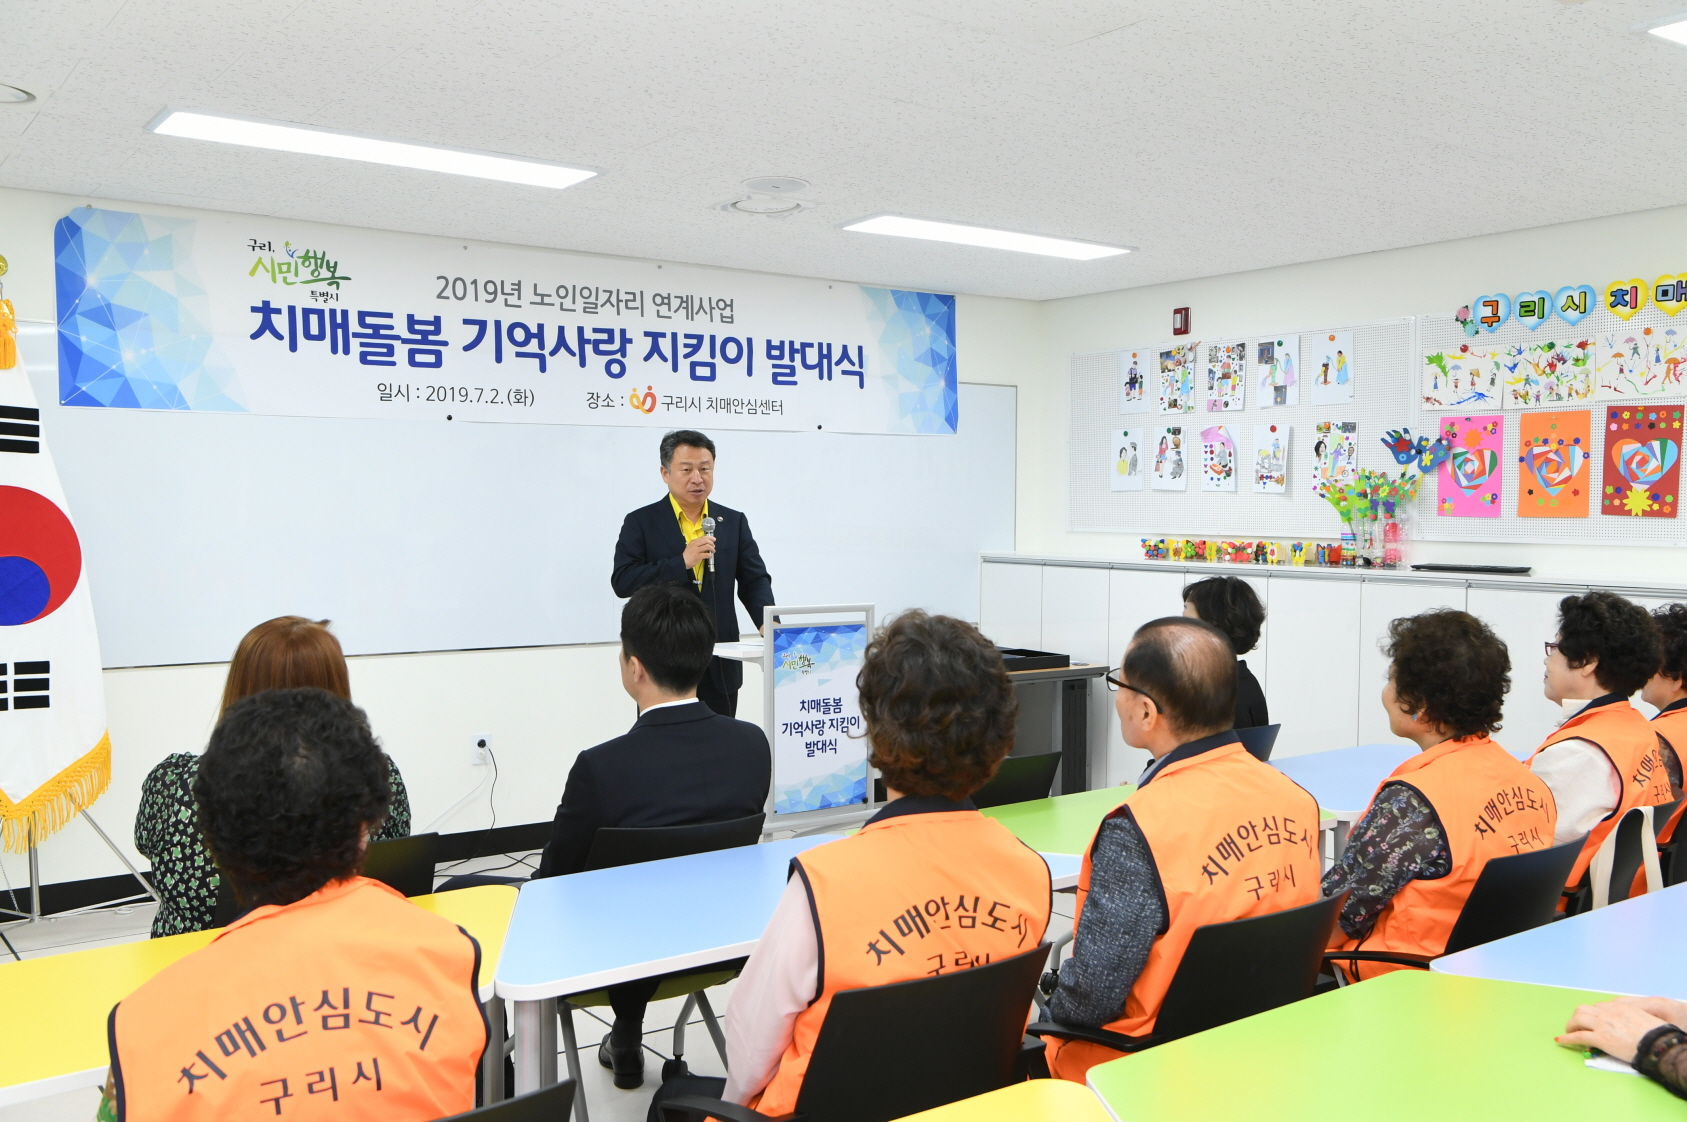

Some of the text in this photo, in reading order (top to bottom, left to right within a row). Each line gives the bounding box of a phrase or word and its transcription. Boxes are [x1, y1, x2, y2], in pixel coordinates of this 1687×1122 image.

[247, 238, 275, 253] 구리,
[248, 248, 351, 291] 시민행복
[309, 290, 339, 303] 특별시
[436, 275, 735, 324] 2019년 노인일자리 연계사업
[1480, 291, 1587, 328] 구리시
[249, 299, 865, 389] 치매돌봄 기억사랑 지킴이 발대식
[377, 383, 411, 402] 일시
[426, 385, 535, 407] 2019.7.2.(화)
[586, 391, 616, 409] 장소
[661, 395, 702, 413] 구리시
[706, 396, 783, 416] 치매안심센터
[799, 697, 843, 715] 치매돌봄
[782, 716, 860, 737] 기억사랑 지킴이
[805, 739, 837, 757] 발대식
[1474, 786, 1550, 840] 치매안심도시
[1201, 815, 1313, 885] 치매안심도시
[1507, 827, 1545, 854] 구리시
[1244, 864, 1296, 901] 구리시
[866, 894, 1028, 966] 치매안심도시
[177, 987, 439, 1095] 치매안심도시
[259, 1057, 383, 1115] 구리시
